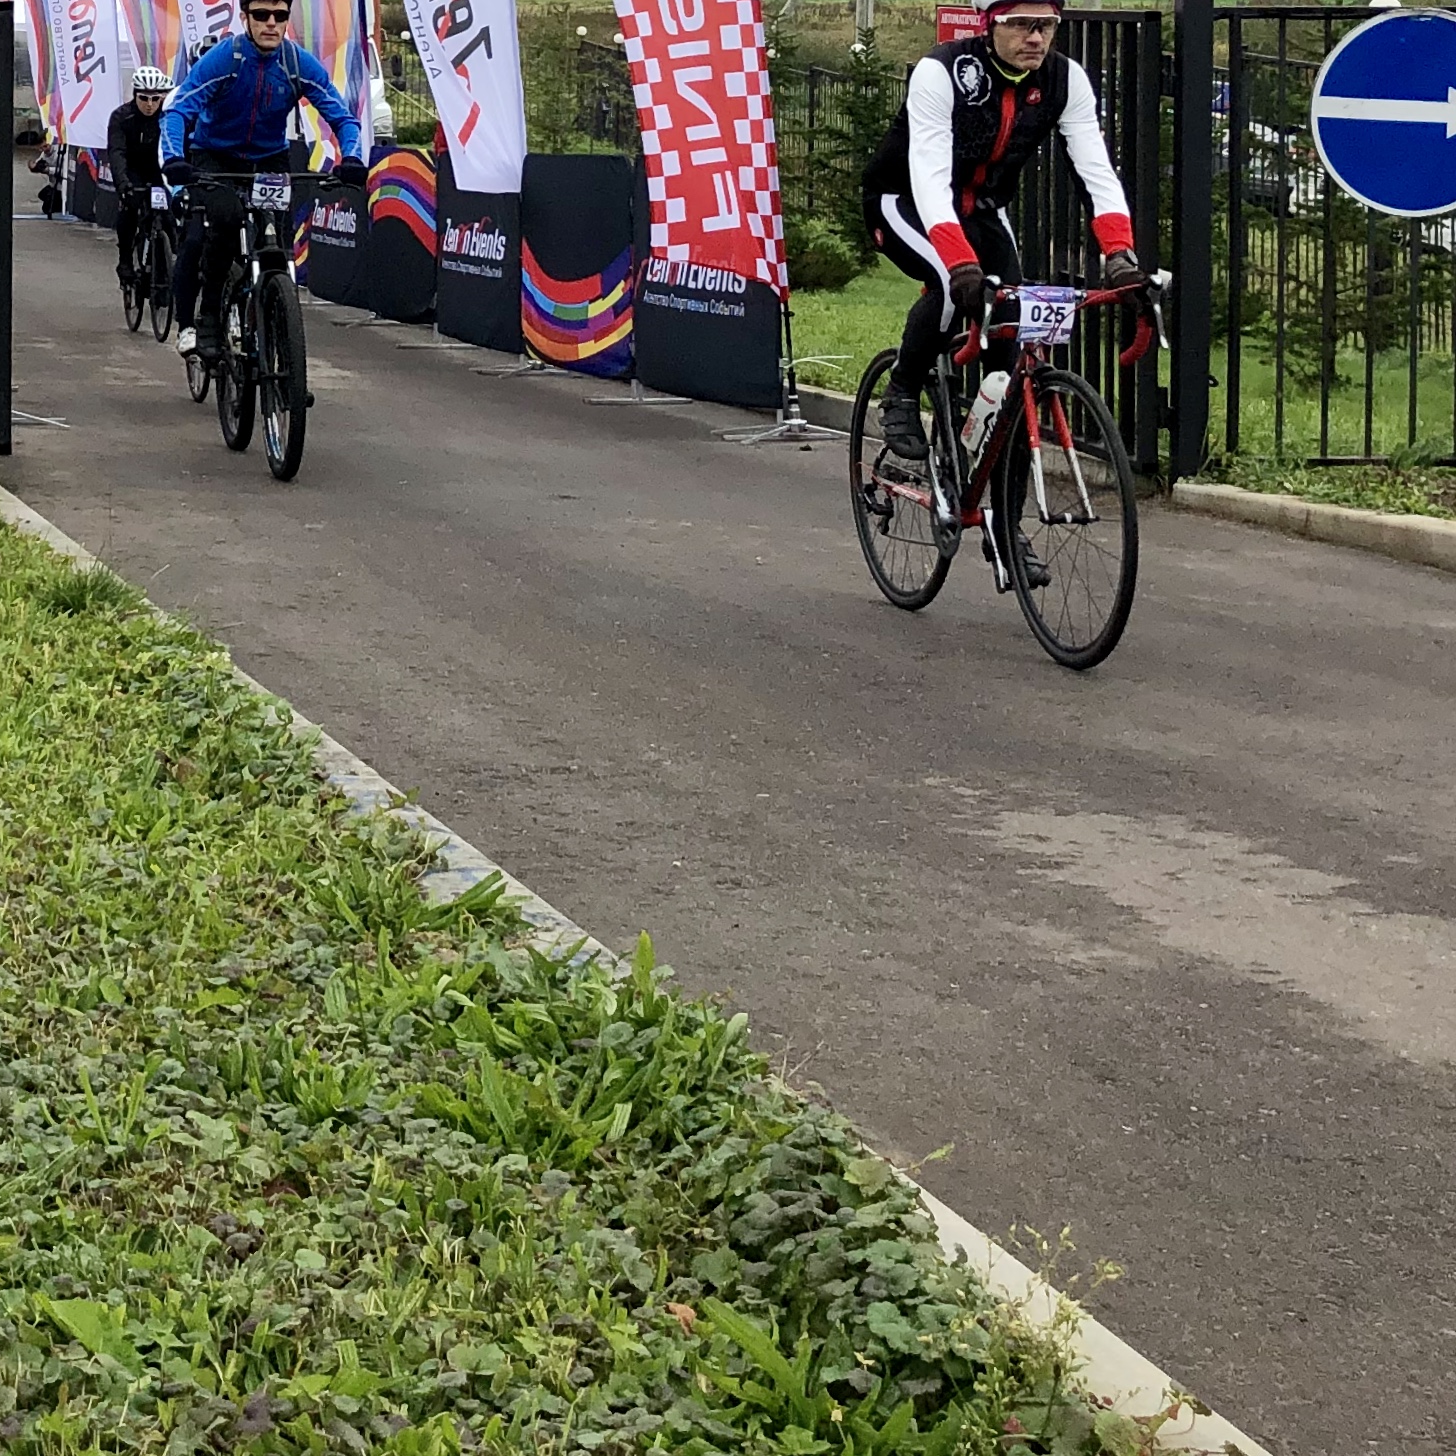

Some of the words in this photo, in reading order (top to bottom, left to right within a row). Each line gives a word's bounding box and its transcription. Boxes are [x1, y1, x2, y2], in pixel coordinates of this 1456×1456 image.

[260, 187, 284, 199] 072
[469, 222, 506, 261] Events
[1031, 305, 1066, 323] 025
